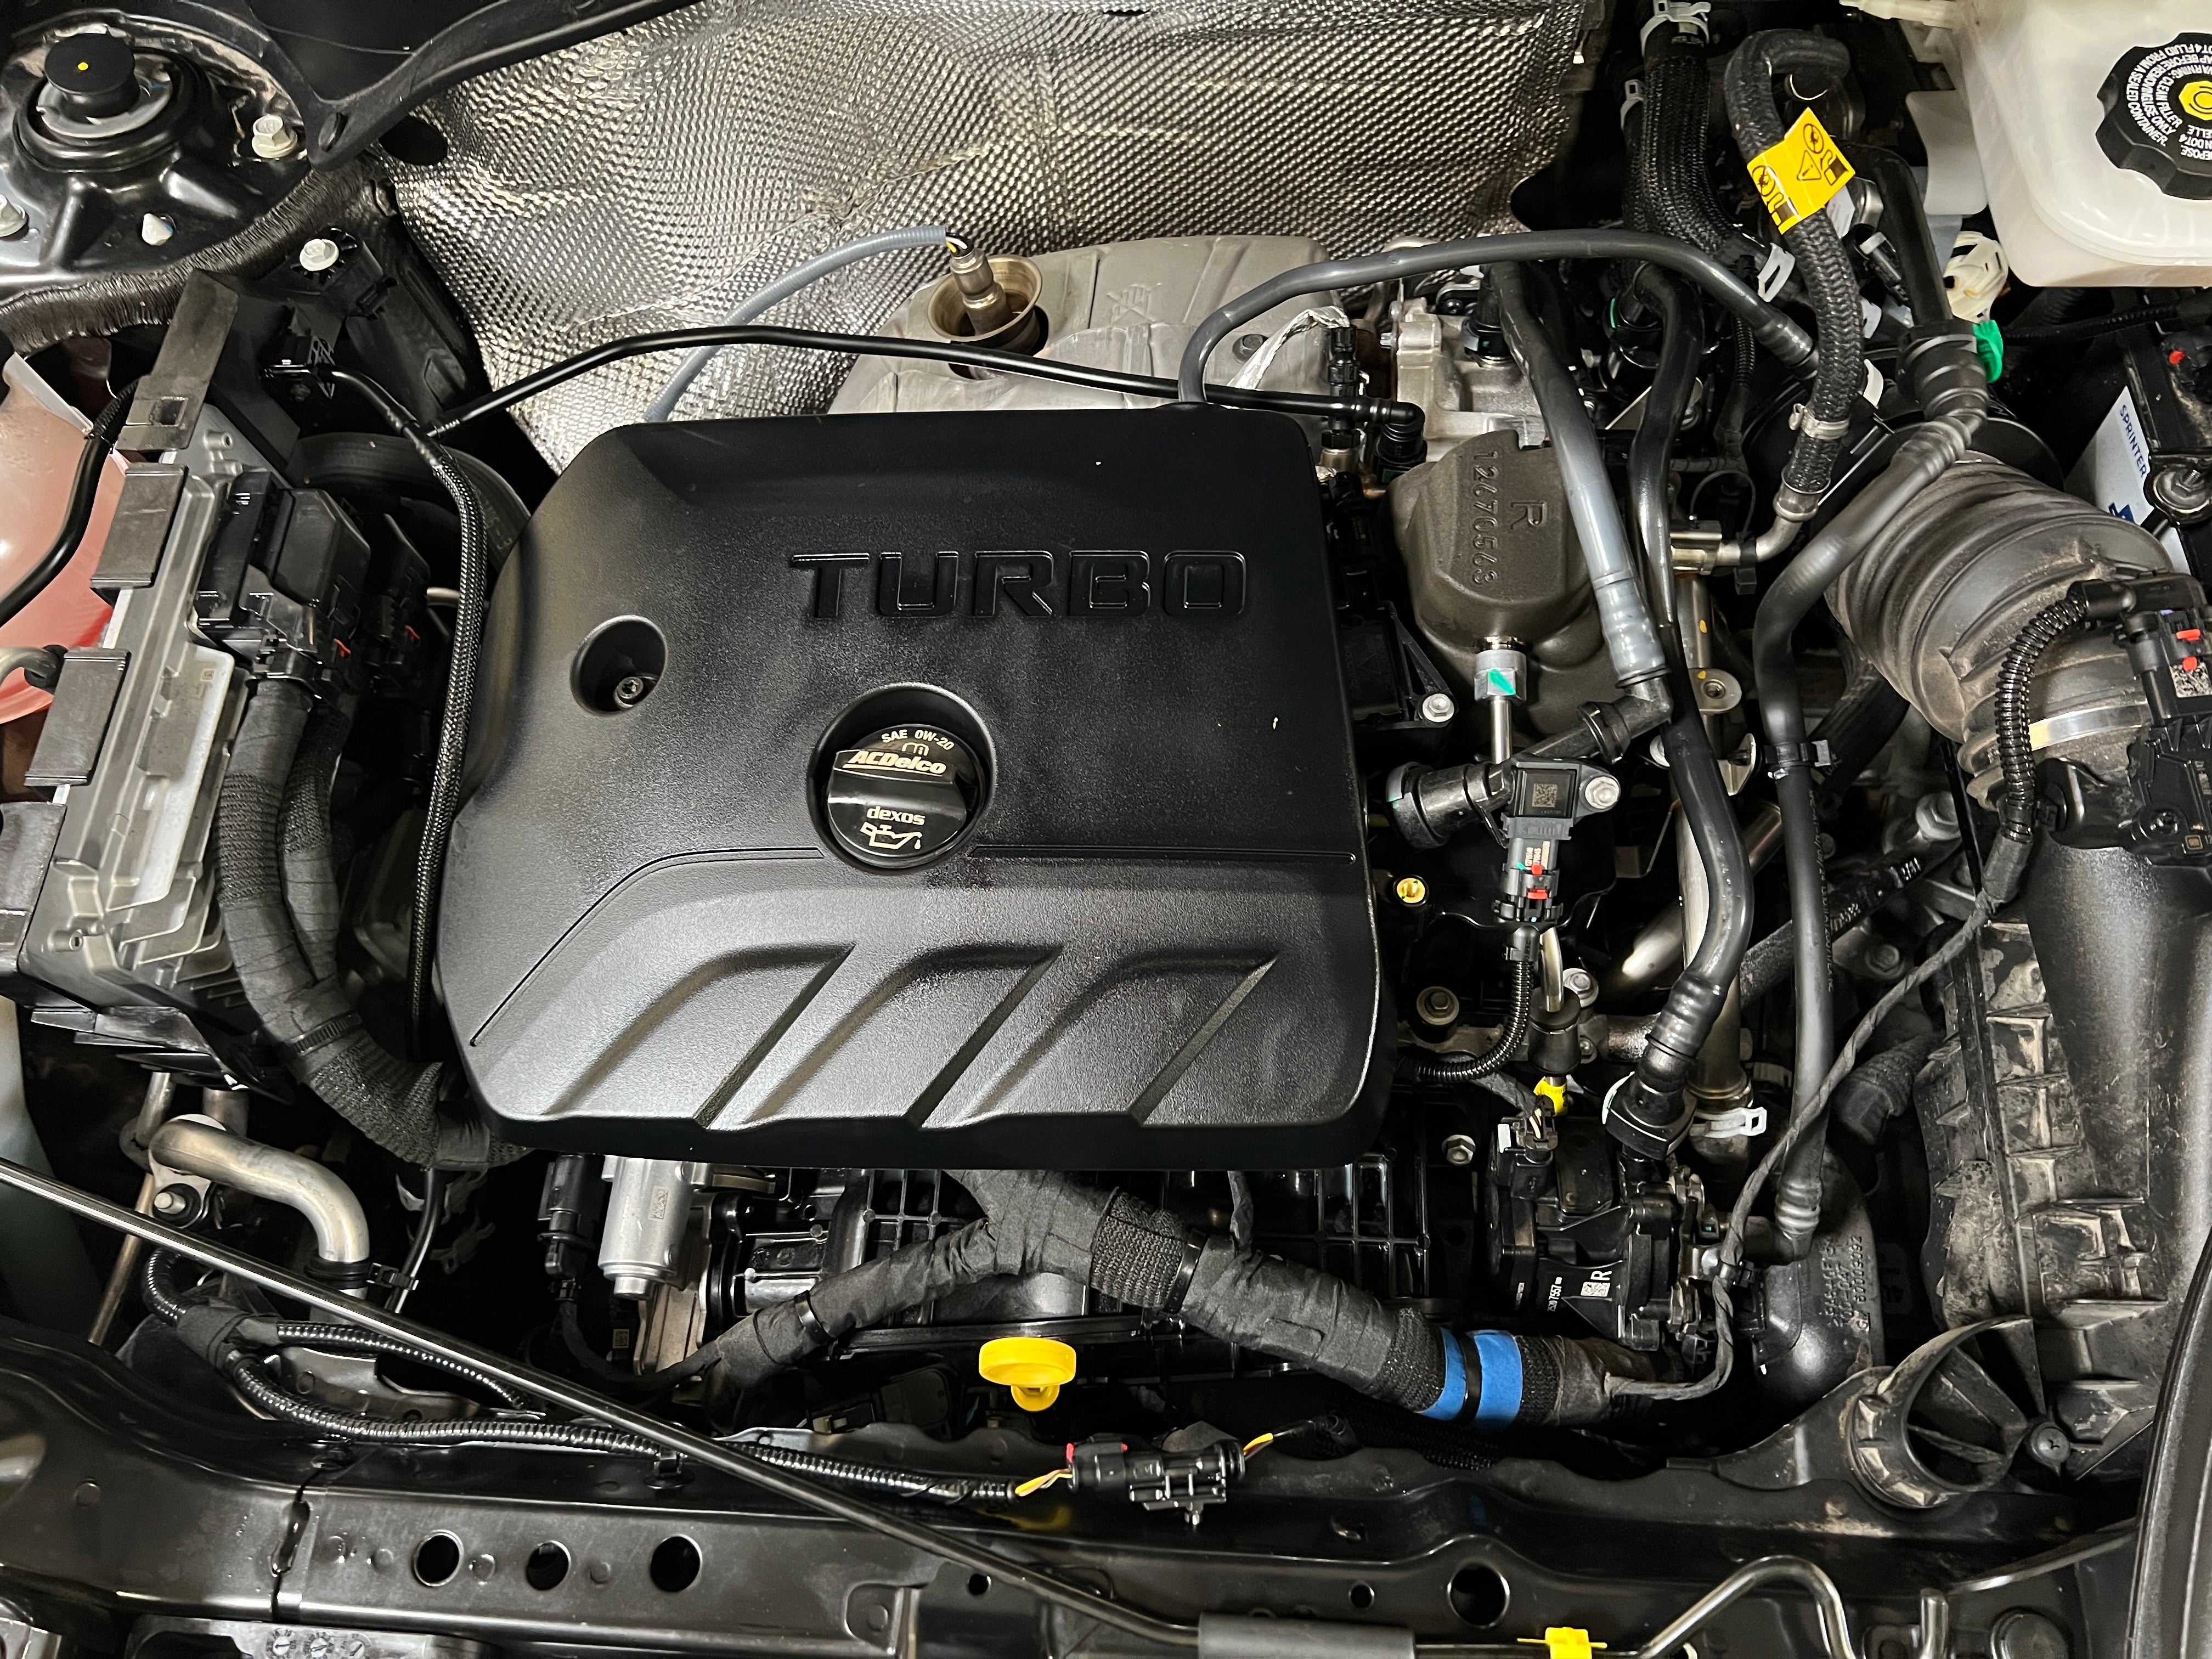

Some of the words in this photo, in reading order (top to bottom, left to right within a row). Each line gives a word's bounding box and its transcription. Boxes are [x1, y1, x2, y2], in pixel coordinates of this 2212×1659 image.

[2164, 44, 2194, 56] FLUID
[2194, 43, 2202, 53] 4
[2202, 44, 2212, 54] OT
[2134, 65, 2146, 73] A
[2139, 50, 2167, 69] FROM
[2160, 54, 2199, 70] BEFORE
[2199, 55, 2212, 64] AP
[2126, 71, 2143, 101] SEALED
[2155, 76, 2174, 101] CLEAN
[2142, 101, 2159, 117] USE
[2157, 102, 2183, 128] FILLER
[2128, 101, 2168, 146] CONTAINER.
[2151, 116, 2176, 135] ONLY
[2187, 124, 2212, 138] ELLE
[2179, 133, 2187, 143] 4
[2185, 137, 2204, 149] DOT
[2180, 144, 2212, 160] EPOSE.
[2119, 404, 2148, 478] SPRINTER
[1471, 450, 1499, 586] 12670563
[1510, 500, 1548, 530] R
[792, 549, 1247, 619] TURBO
[881, 730, 909, 743] SAE
[915, 729, 955, 751] 0W-20
[847, 751, 947, 775] ACDelco
[866, 806, 926, 826] dexos
[1590, 1271, 1612, 1281] R
